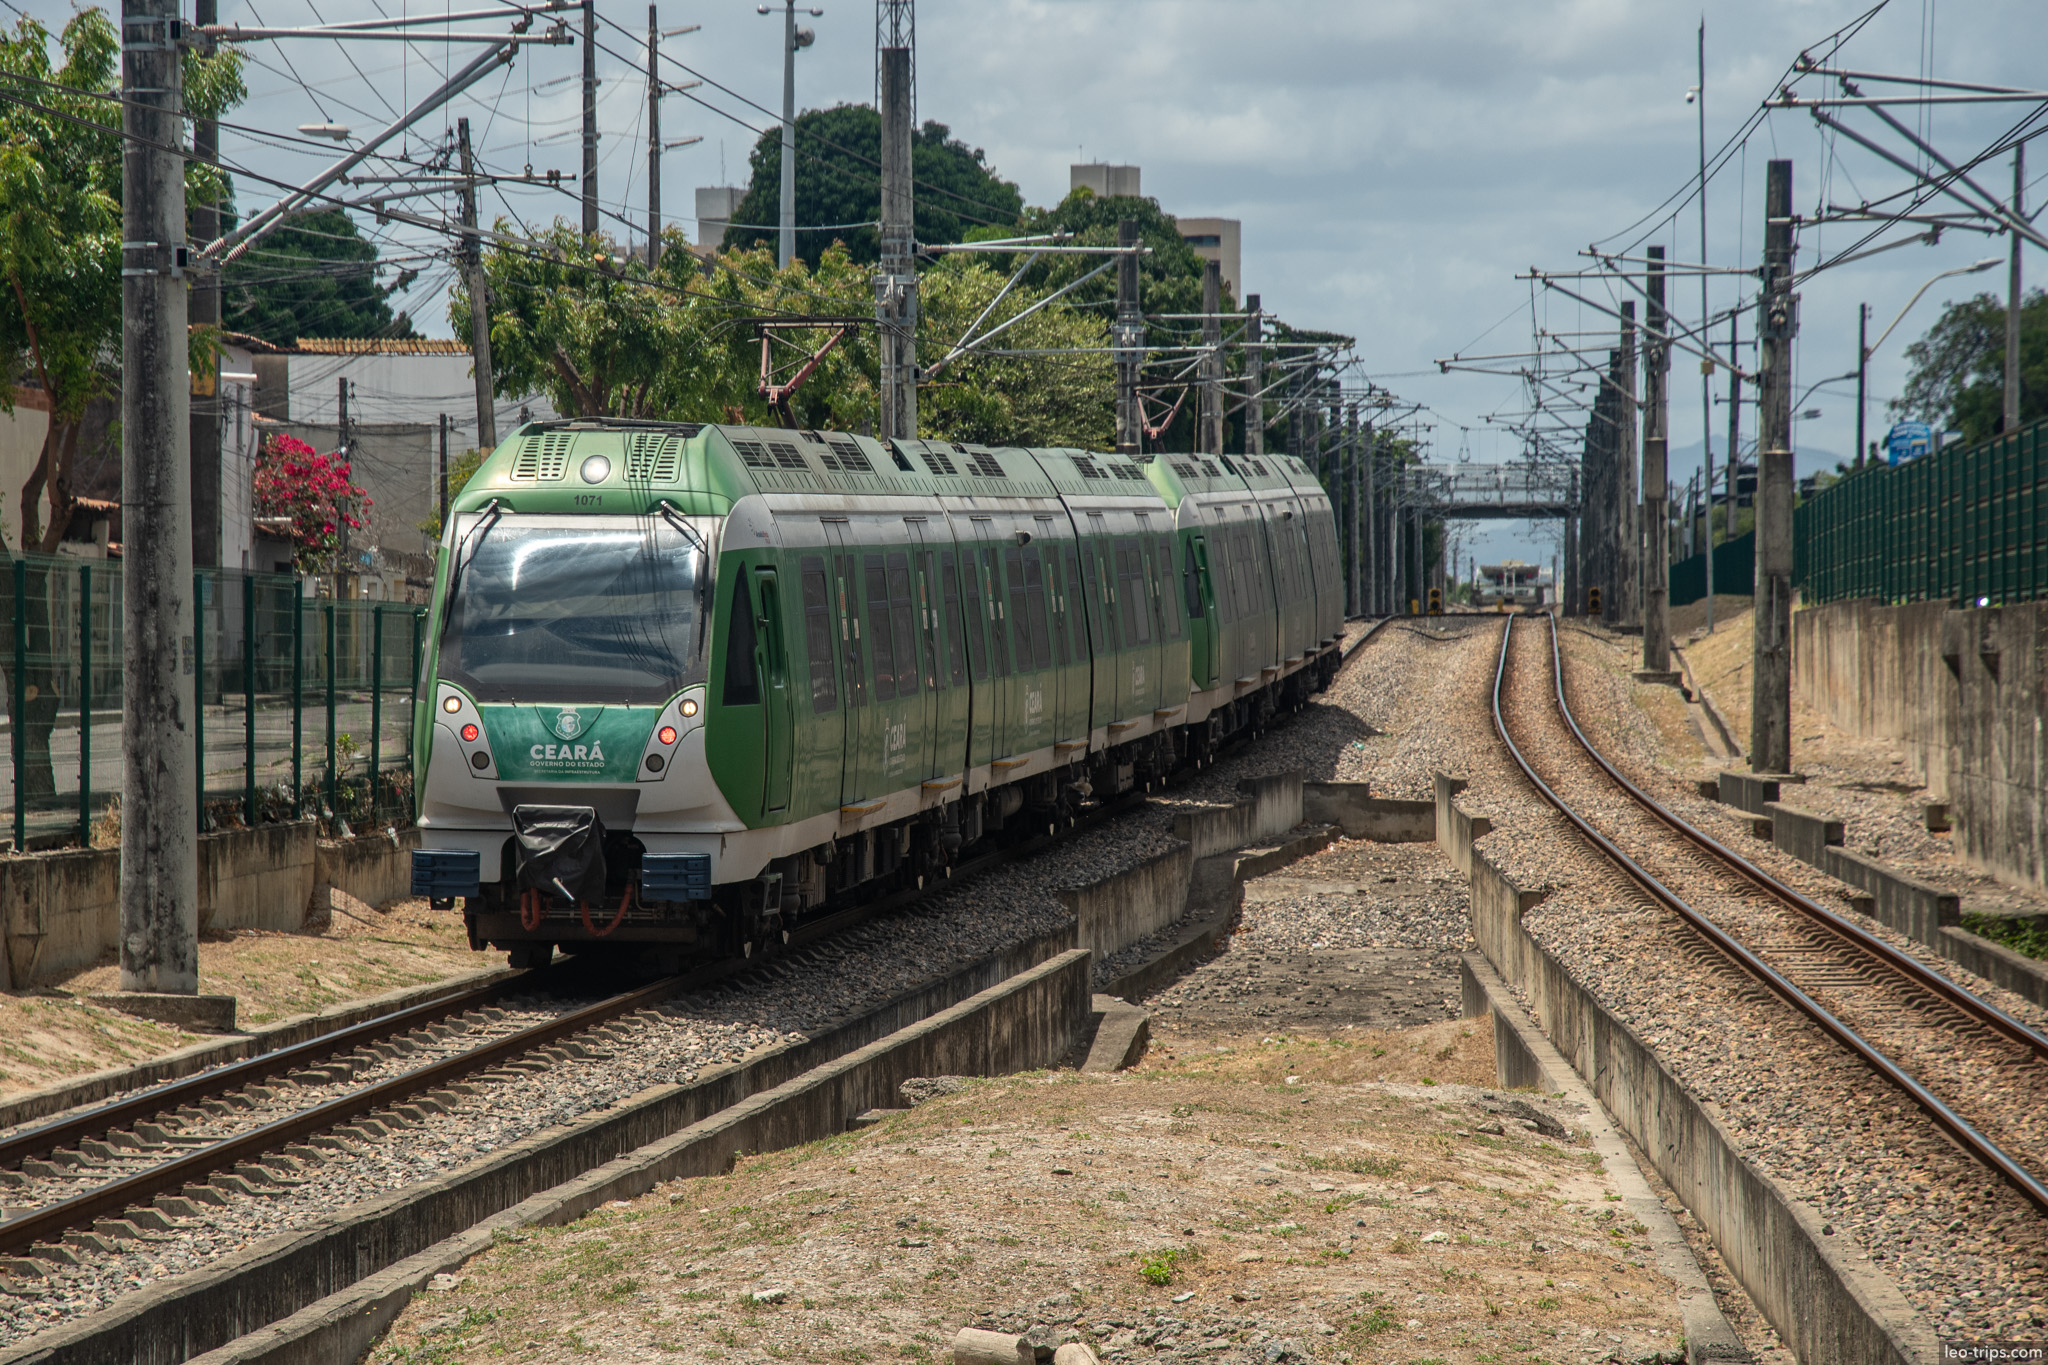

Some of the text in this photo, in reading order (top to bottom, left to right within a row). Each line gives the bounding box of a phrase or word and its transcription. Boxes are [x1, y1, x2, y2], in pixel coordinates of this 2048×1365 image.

[574, 495, 602, 506] 1071
[890, 713, 907, 752] CEARÁ
[530, 740, 605, 761] CEARÁ
